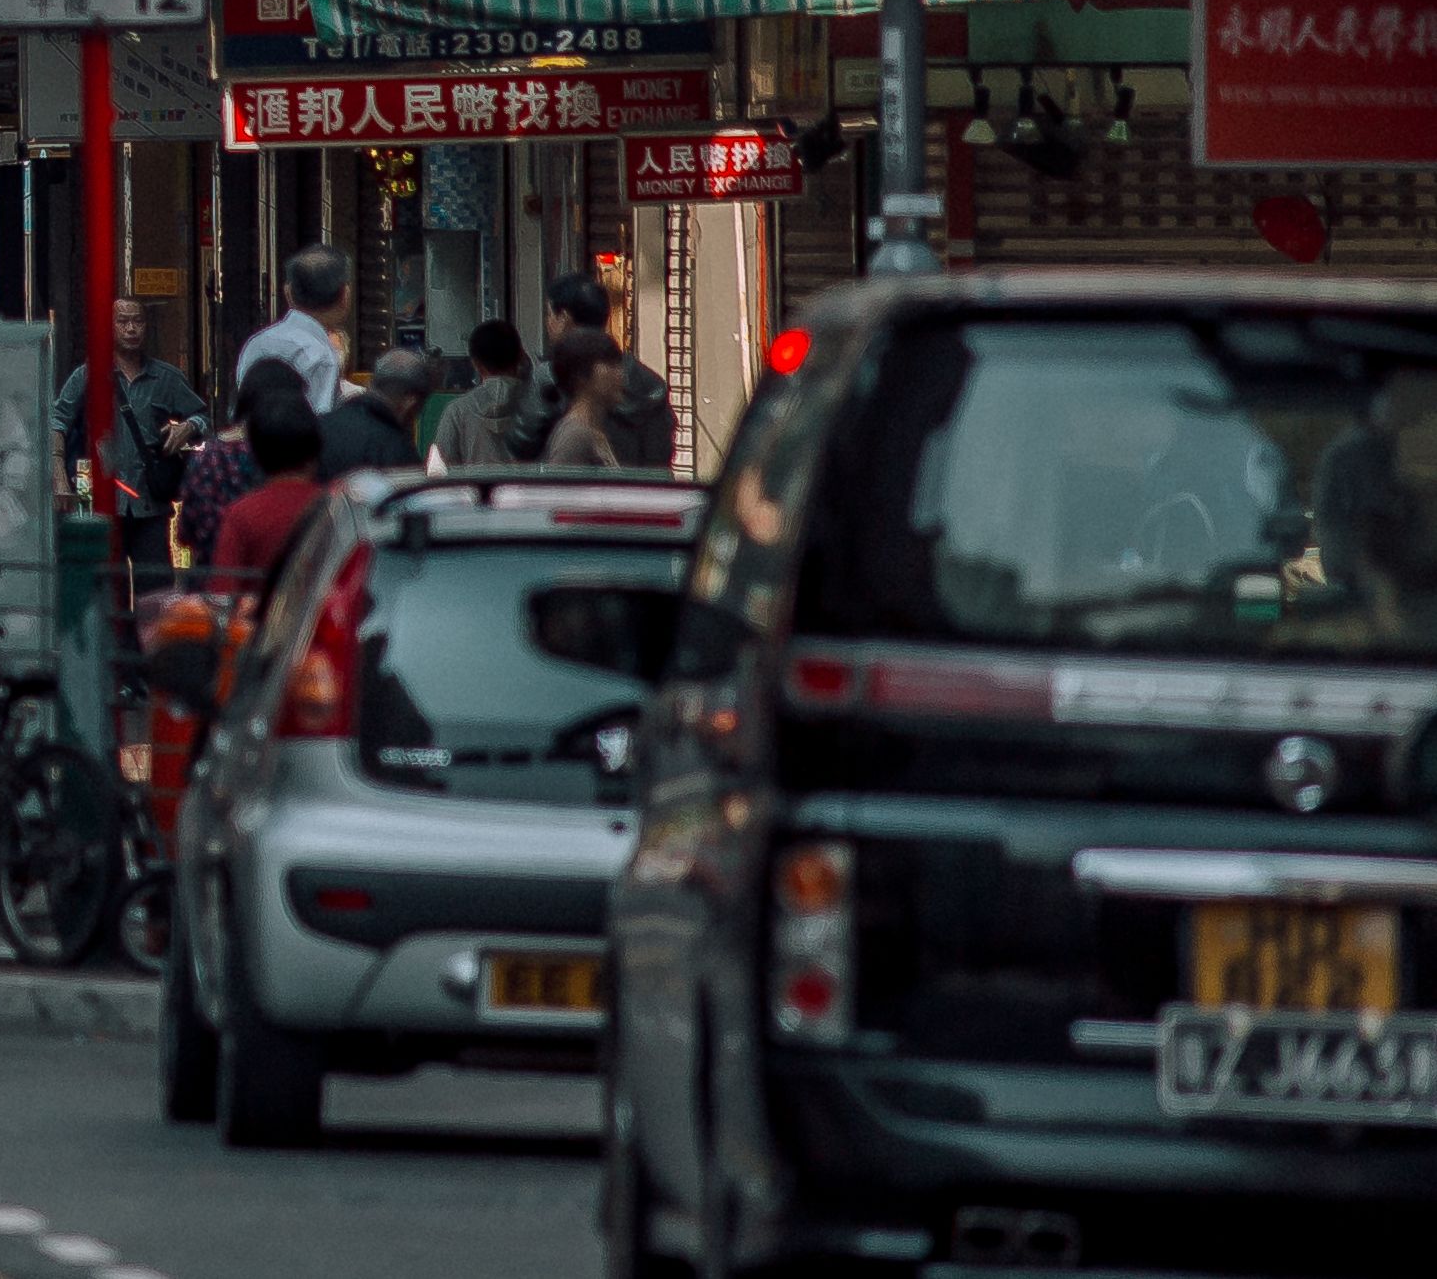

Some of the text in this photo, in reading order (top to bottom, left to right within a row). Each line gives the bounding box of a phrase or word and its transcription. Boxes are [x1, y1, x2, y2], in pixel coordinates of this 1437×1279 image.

[622, 78, 685, 101] MONEY
[605, 104, 700, 128] EXCHANGE
[635, 174, 793, 196] MONEY EXCHANGE
